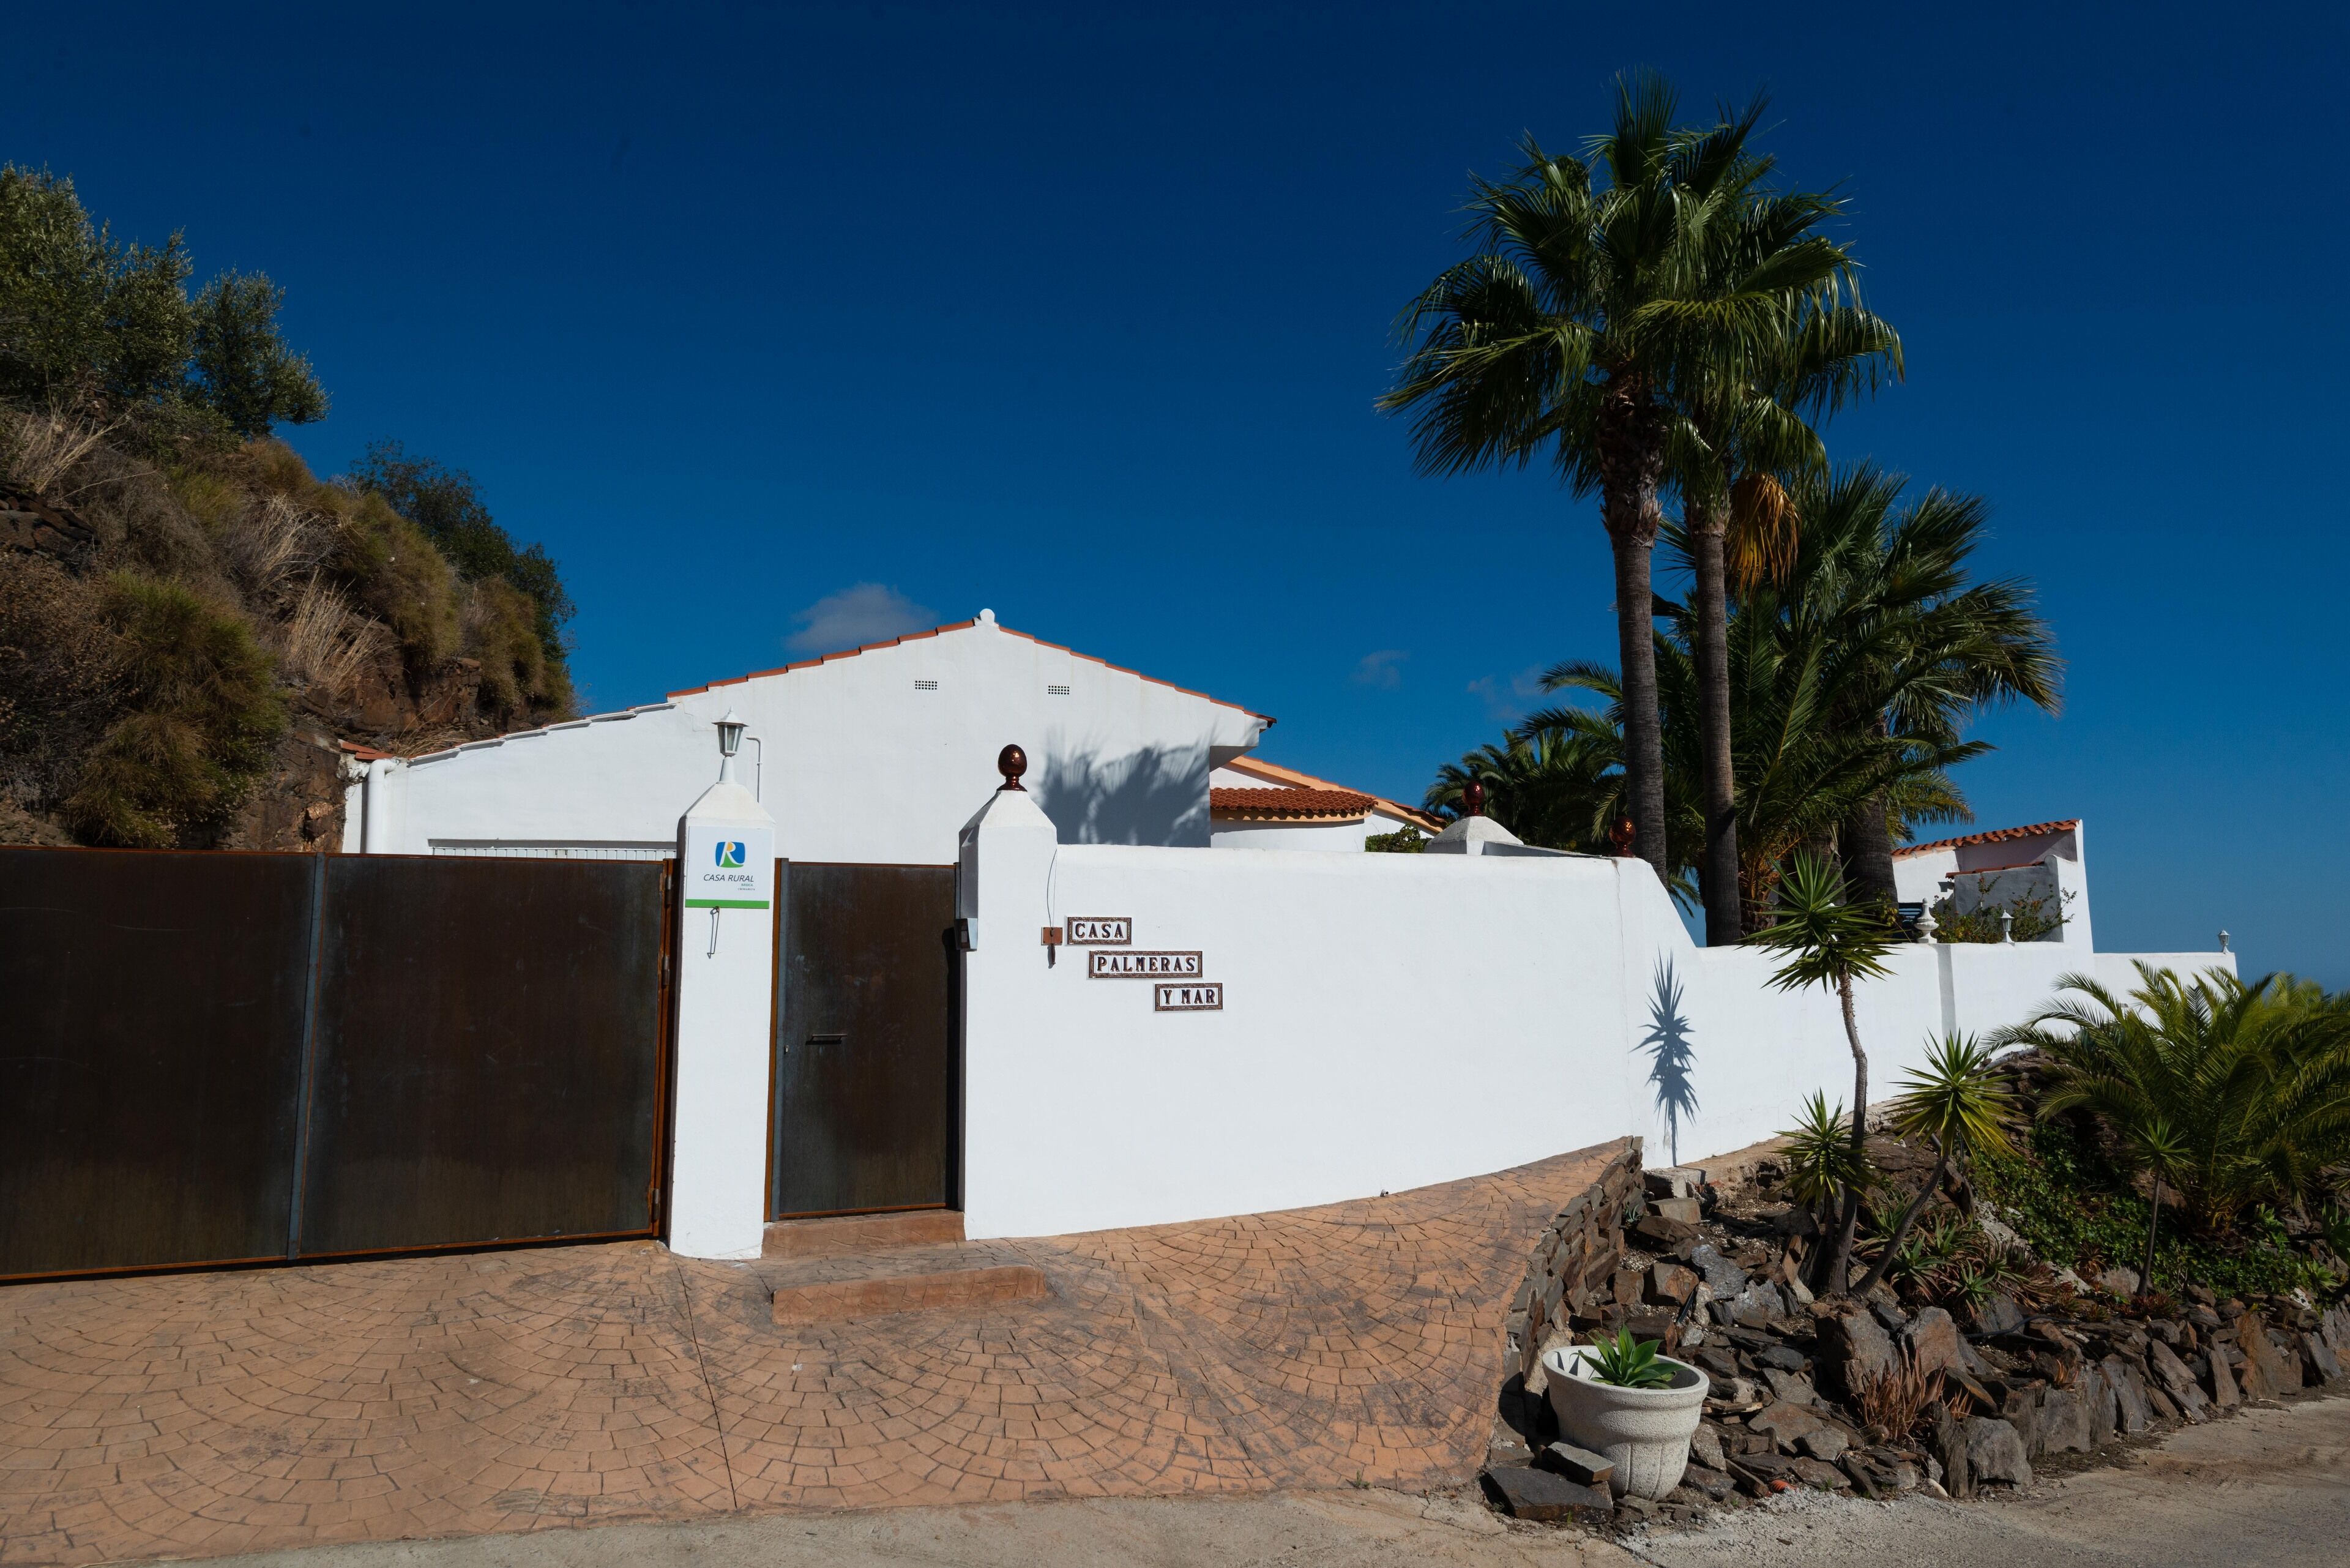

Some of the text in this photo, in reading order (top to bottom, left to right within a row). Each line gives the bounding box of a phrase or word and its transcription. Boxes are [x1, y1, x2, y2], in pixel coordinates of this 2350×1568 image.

[1075, 923, 1124, 938] CASA
[1097, 956, 1196, 972] PALMERAS
[1163, 988, 1215, 1005] Y MAR
